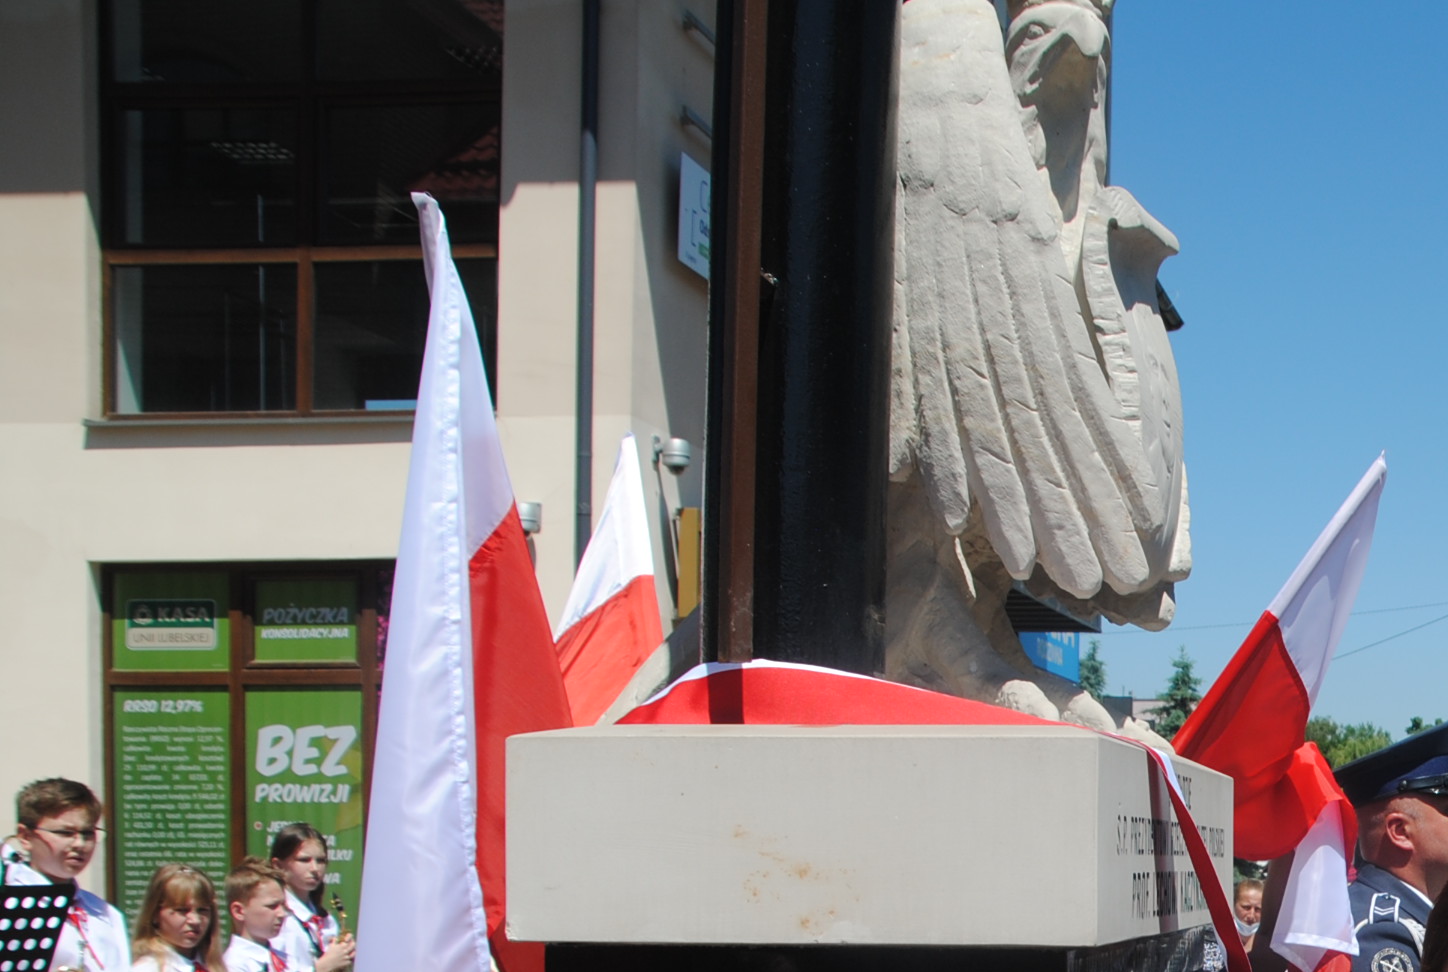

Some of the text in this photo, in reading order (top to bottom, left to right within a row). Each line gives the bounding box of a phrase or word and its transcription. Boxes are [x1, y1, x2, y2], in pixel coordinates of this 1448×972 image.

[157, 606, 211, 623] KASA
[262, 602, 349, 625] POŻYCZKA
[132, 632, 210, 644] UNII LUBELSKIEJ
[260, 627, 351, 640] KONSOLIDACYJNA
[254, 723, 358, 778] BEZ
[254, 783, 351, 804] PROWIZJI
